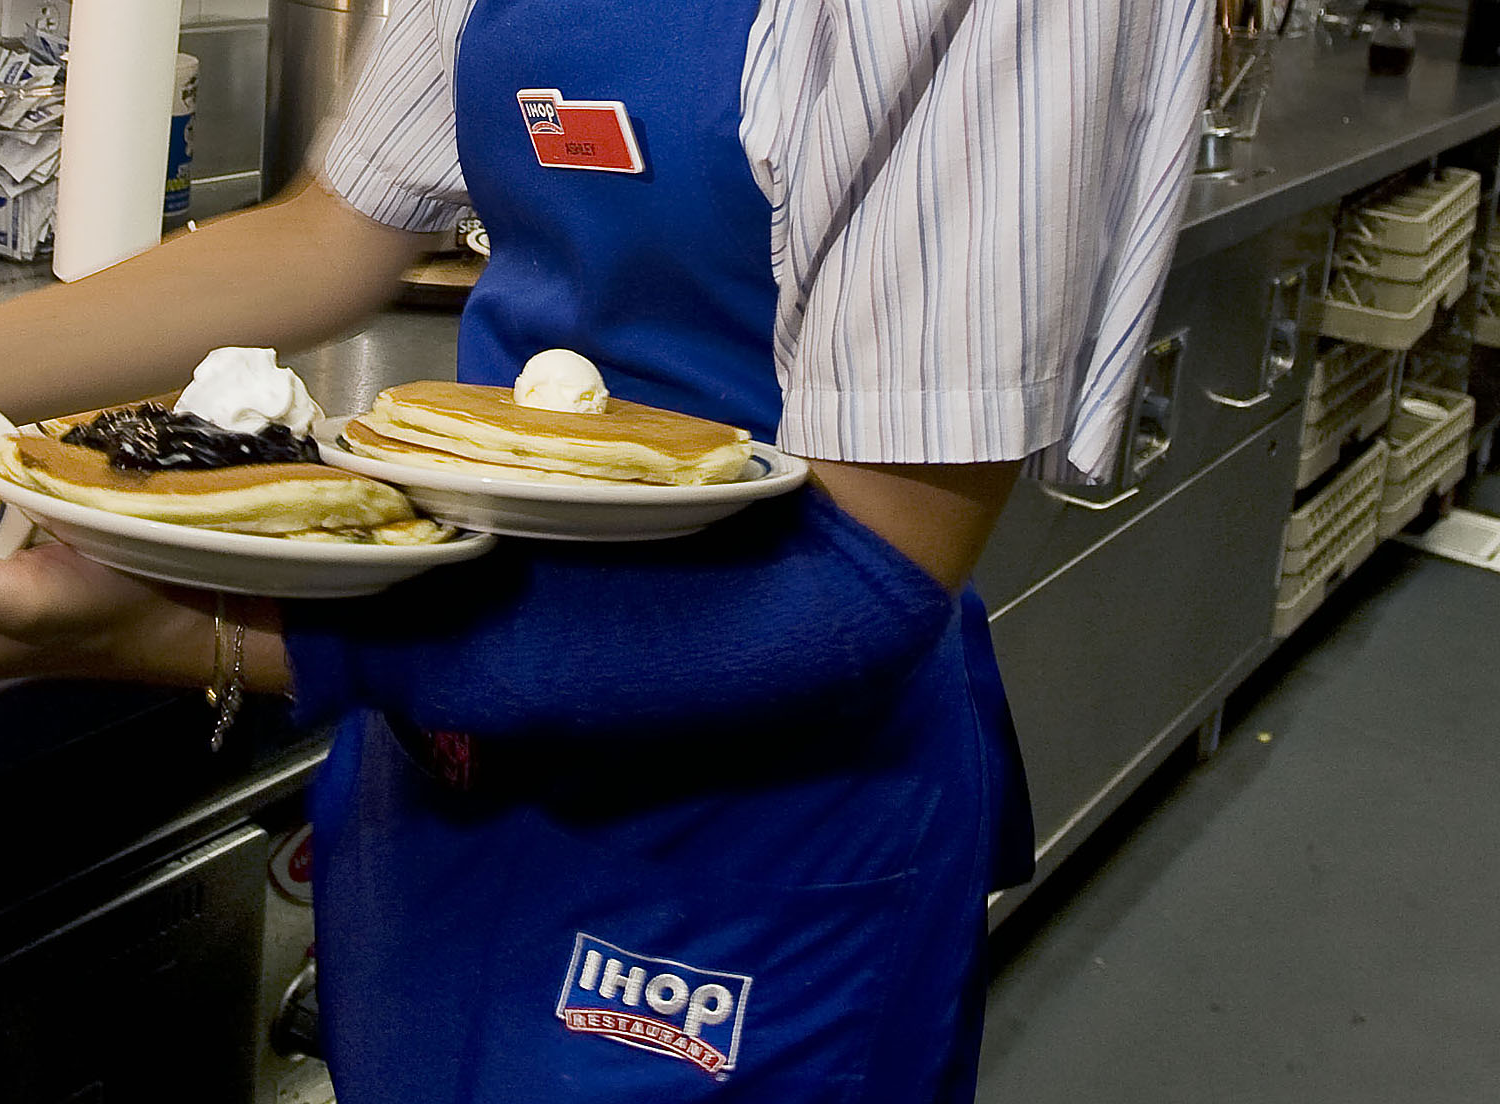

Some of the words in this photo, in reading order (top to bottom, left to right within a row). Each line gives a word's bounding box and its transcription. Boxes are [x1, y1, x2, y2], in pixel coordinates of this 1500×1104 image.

[524, 102, 555, 122] IHOP
[579, 950, 733, 1037] IHOP
[572, 1013, 719, 1064] RESTAURANT
